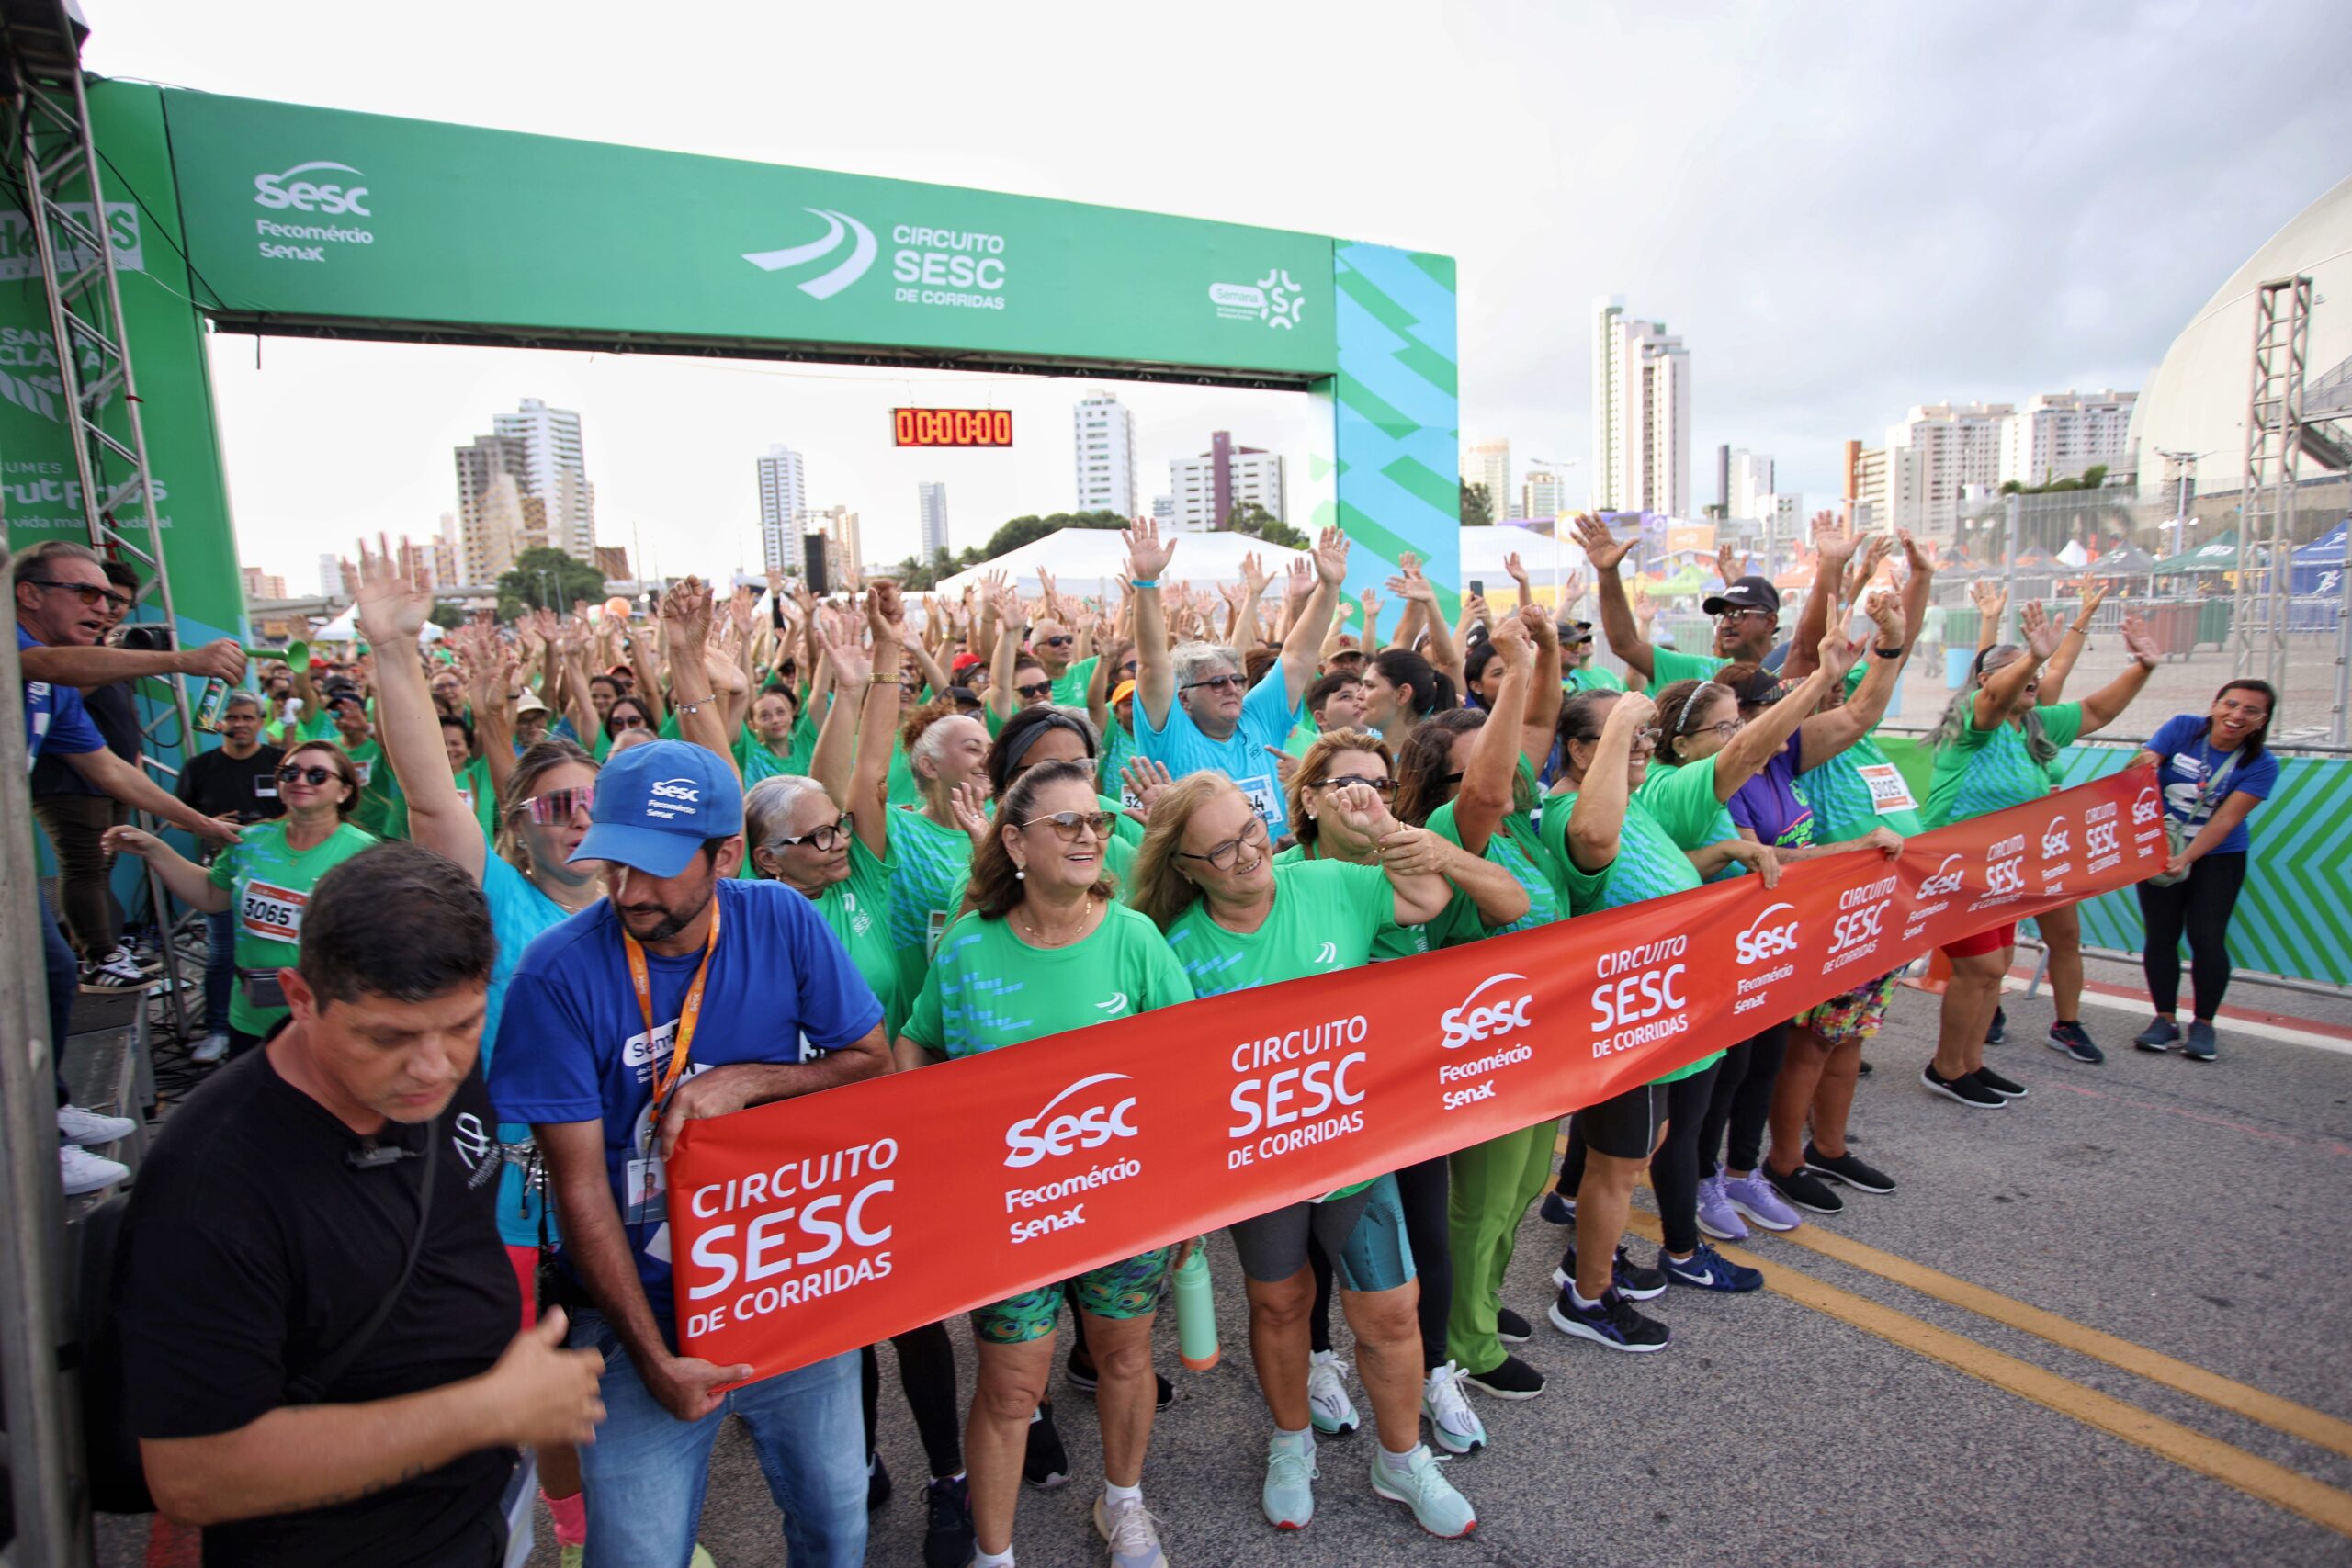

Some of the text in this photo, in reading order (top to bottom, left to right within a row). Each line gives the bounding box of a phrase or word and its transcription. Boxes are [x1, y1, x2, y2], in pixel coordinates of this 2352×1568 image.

[254, 161, 371, 216] Sesc
[256, 219, 374, 244] Fecomércio
[258, 241, 325, 262] Senac
[892, 224, 1004, 254] CIRCUITO
[892, 249, 1006, 290] SESC
[895, 288, 1005, 310] DE CORRIDAS
[0, 344, 102, 368] CLAA
[2, 327, 93, 349] SANA
[896, 411, 1011, 444] 00:00:00
[2, 462, 62, 475] UMES
[14, 515, 50, 528] vida
[54, 515, 91, 528] mai
[650, 778, 699, 802] Sesc
[2086, 820, 2120, 859] SESC
[1839, 875, 1897, 910] CIRCUITO
[1979, 855, 2025, 898] SESC
[243, 897, 293, 925] 3065
[1827, 899, 1891, 954] SESC
[1736, 902, 1799, 965] Sesc
[1597, 934, 1687, 978] CIRCUITO
[1590, 964, 1686, 1032] SESC
[1737, 963, 1793, 995] Fecomércio
[1441, 972, 1532, 1049] Sesc
[1733, 991, 1768, 1015] Senac
[1231, 1015, 1367, 1072] CIRCUITO
[1592, 1013, 1689, 1058] DE CORRIDAS
[1439, 1043, 1532, 1085] Fecomércio
[1229, 1051, 1366, 1137] SESC
[1442, 1079, 1496, 1111] Senac
[1003, 1072, 1138, 1168] Sesc
[1228, 1110, 1363, 1169] DE CORRIDAS
[692, 1138, 898, 1218] CIRCUITO
[1005, 1157, 1141, 1213] Fecomércio
[689, 1179, 895, 1300] SESC
[1010, 1203, 1086, 1244] Senac
[687, 1251, 892, 1337] DE CORRIDAS
